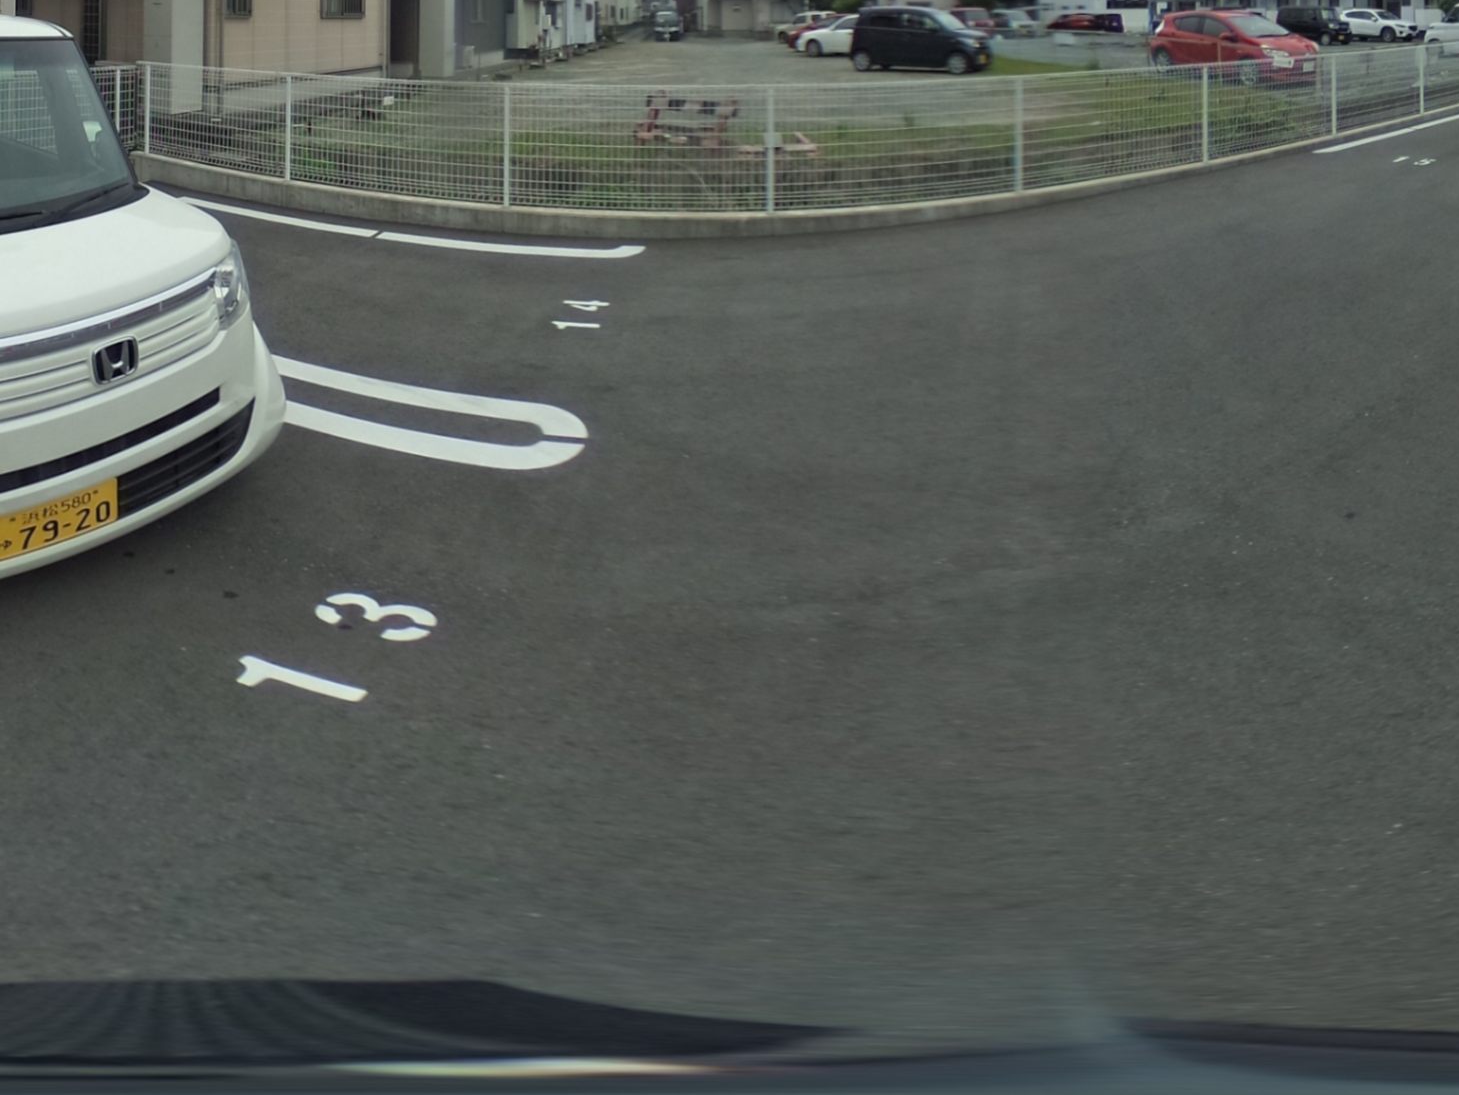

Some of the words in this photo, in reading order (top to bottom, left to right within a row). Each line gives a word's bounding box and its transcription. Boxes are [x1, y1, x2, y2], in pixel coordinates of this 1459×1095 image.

[551, 300, 610, 329] 14
[19, 500, 111, 550] 79-20
[236, 593, 438, 702] 13
